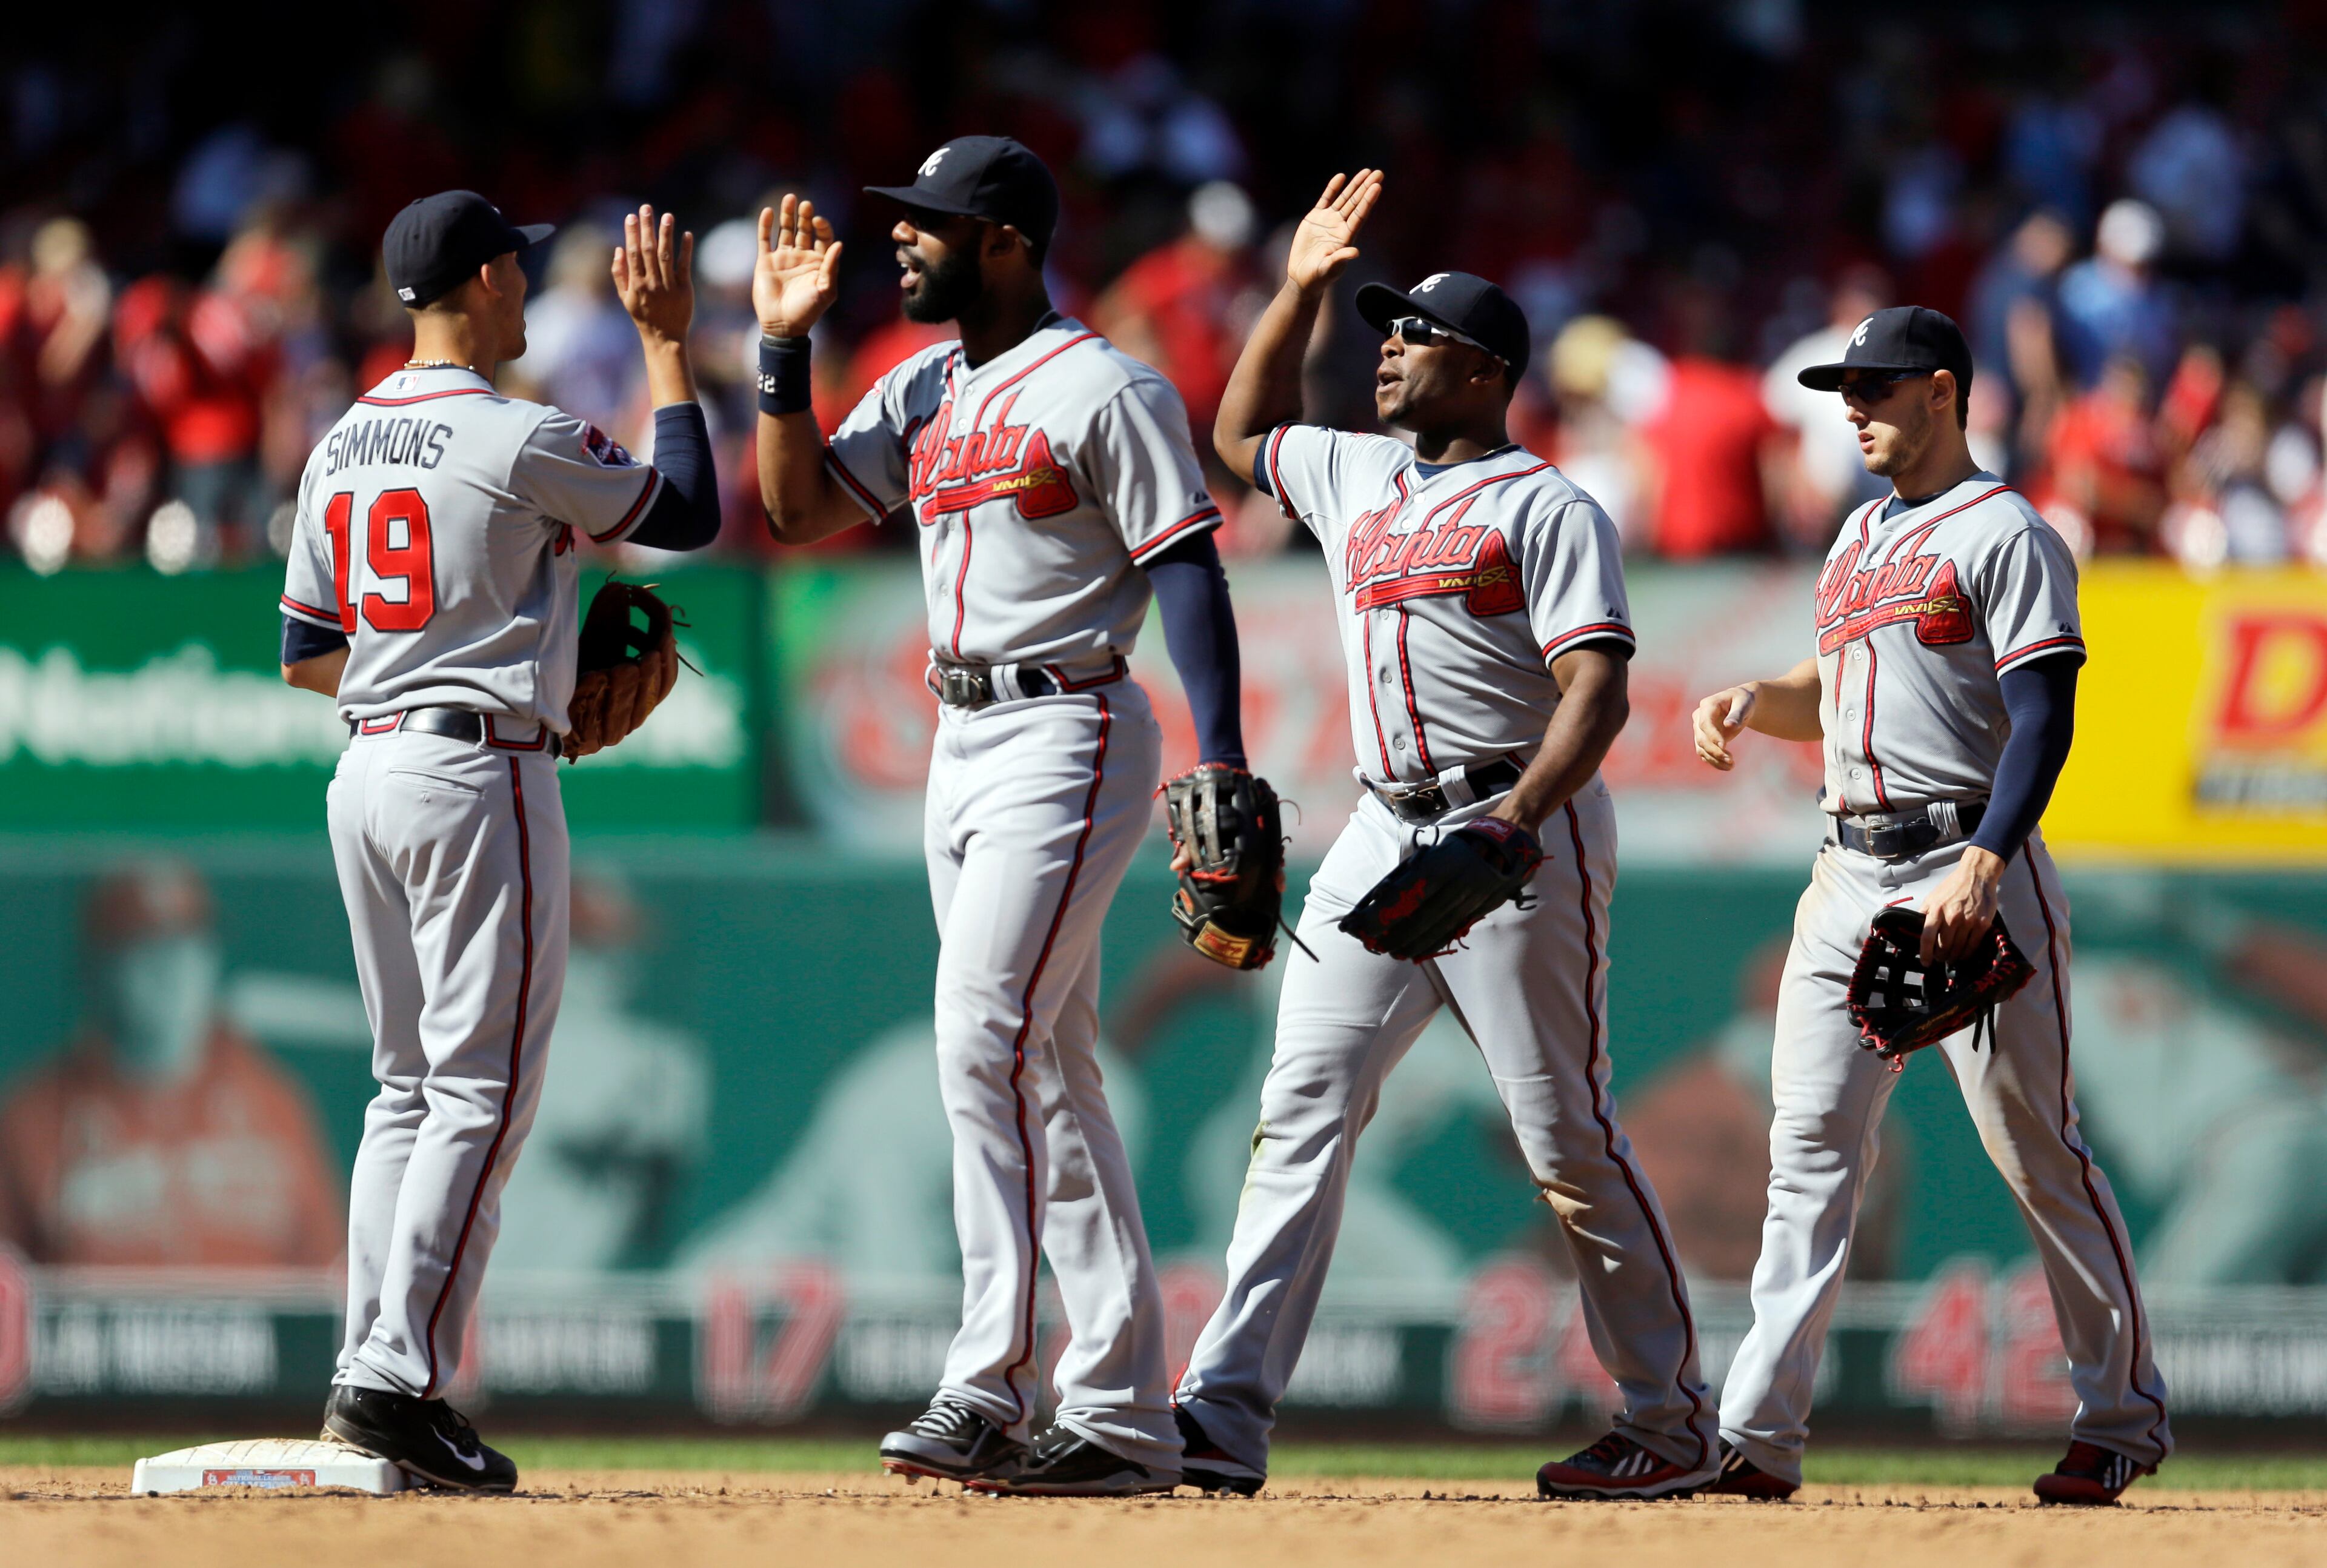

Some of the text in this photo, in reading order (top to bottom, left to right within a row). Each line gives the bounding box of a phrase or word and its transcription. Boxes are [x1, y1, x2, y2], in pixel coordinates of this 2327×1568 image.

[326, 418, 453, 476] SIMMONS
[904, 386, 1030, 502] Atlanta
[325, 487, 436, 635] 19
[1345, 493, 1490, 595] Atlanta
[1815, 523, 1942, 637] Atlanta
